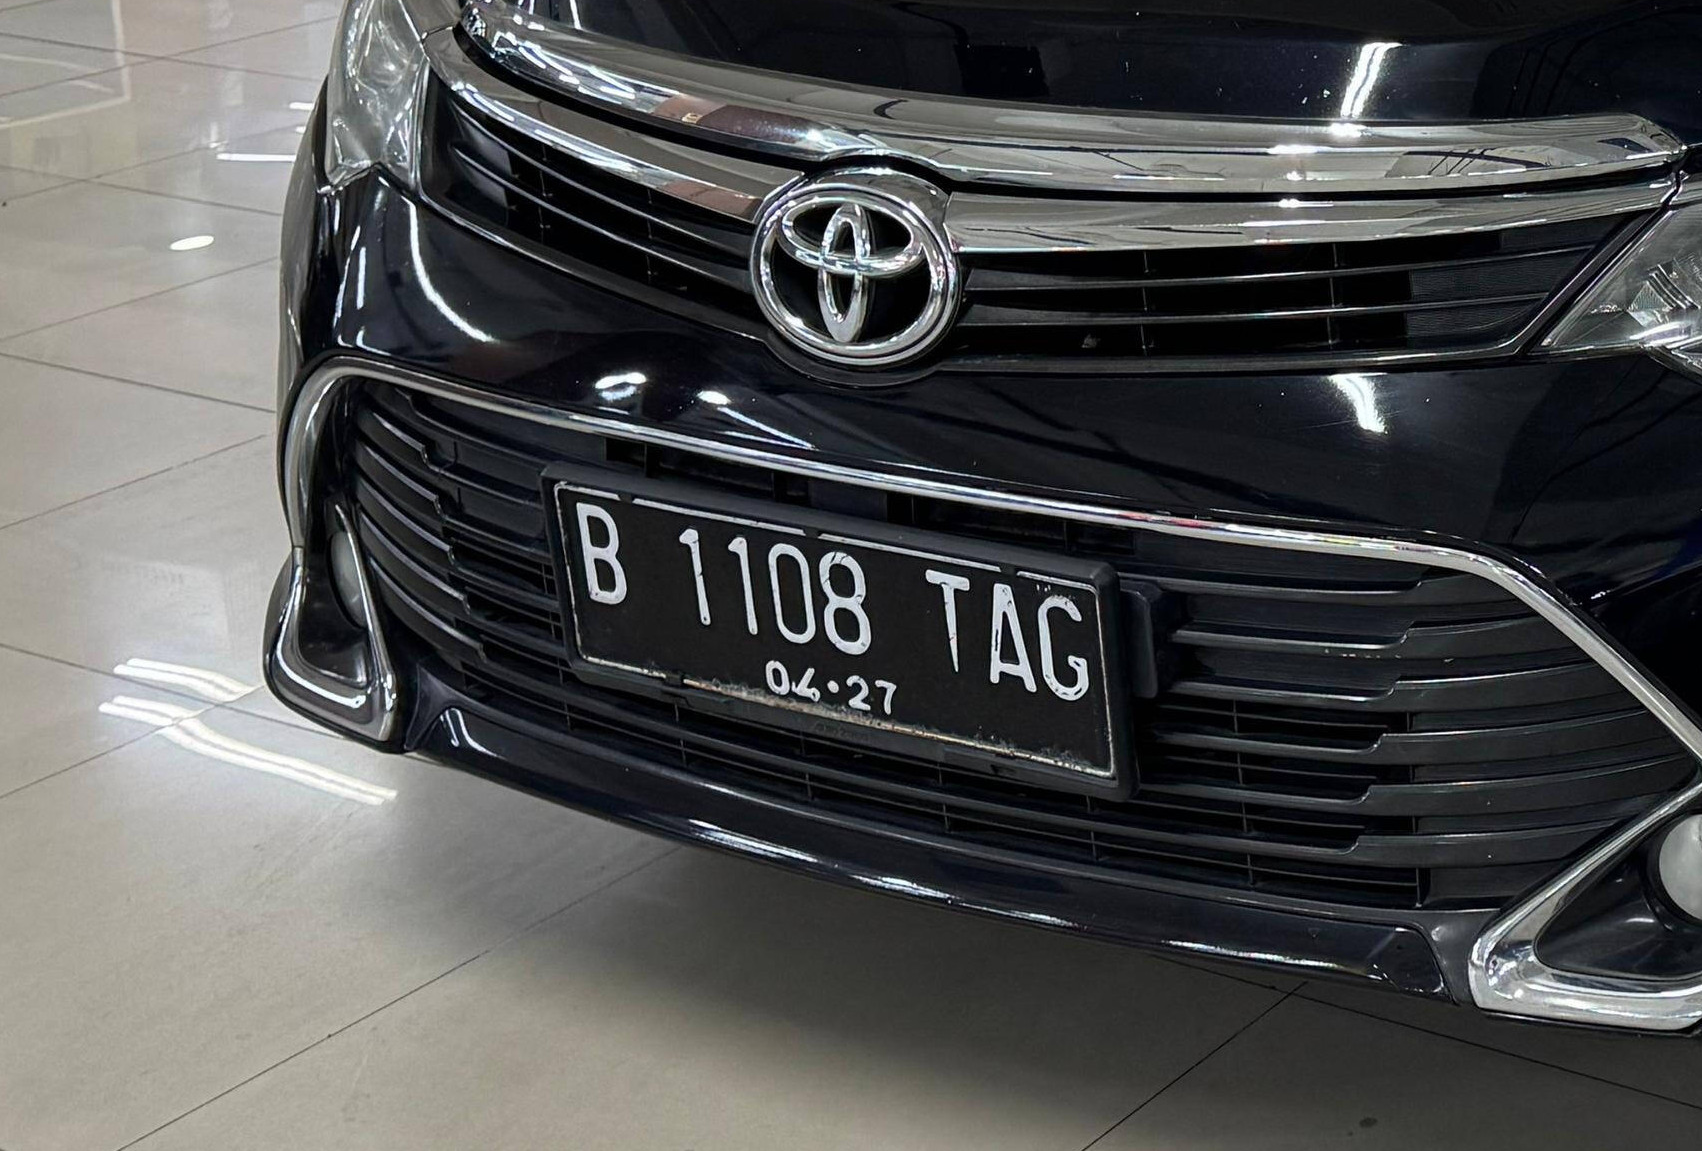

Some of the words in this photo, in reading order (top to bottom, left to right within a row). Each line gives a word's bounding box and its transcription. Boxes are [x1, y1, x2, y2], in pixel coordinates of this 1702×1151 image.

[575, 502, 628, 605] B
[679, 528, 872, 655] 1108
[925, 569, 1089, 702] TAG
